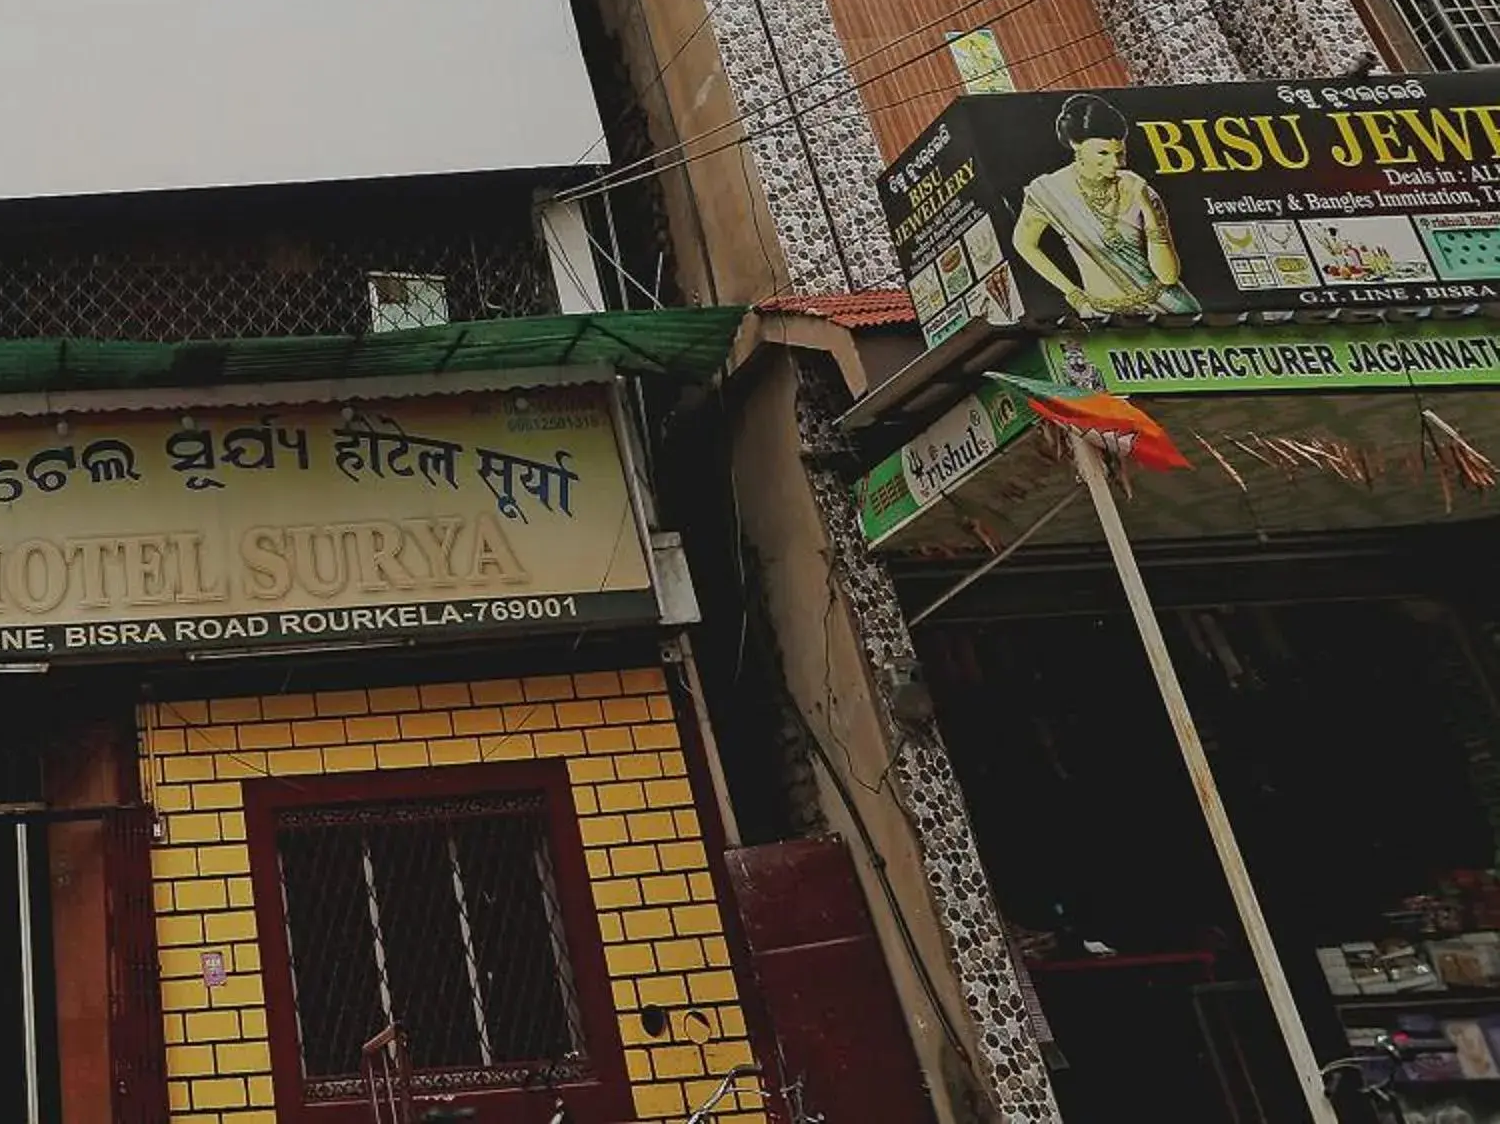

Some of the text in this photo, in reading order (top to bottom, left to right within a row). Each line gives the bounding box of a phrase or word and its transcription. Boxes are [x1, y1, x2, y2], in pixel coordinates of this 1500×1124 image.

[1135, 113, 1310, 175] BISU
[908, 165, 943, 207] BISU
[1382, 167, 1435, 186] Deals
[1435, 167, 1457, 184] in
[893, 157, 976, 247] JEWELLERY
[1203, 193, 1284, 217] Jewellery
[1286, 194, 1303, 212] &
[1304, 191, 1374, 214] Bangles
[1373, 186, 1482, 209] Immitation,
[1300, 290, 1347, 304] G.T.
[1351, 286, 1410, 303] LINE
[1423, 283, 1497, 300] BISRA
[1108, 343, 1343, 383] MANUFACTURER
[475, 449, 580, 525] सूर्या
[239, 513, 531, 600] SURYA
[64, 622, 168, 649] BISRA
[173, 614, 270, 643] ROAD
[279, 594, 580, 636] ROURKELA-769001
